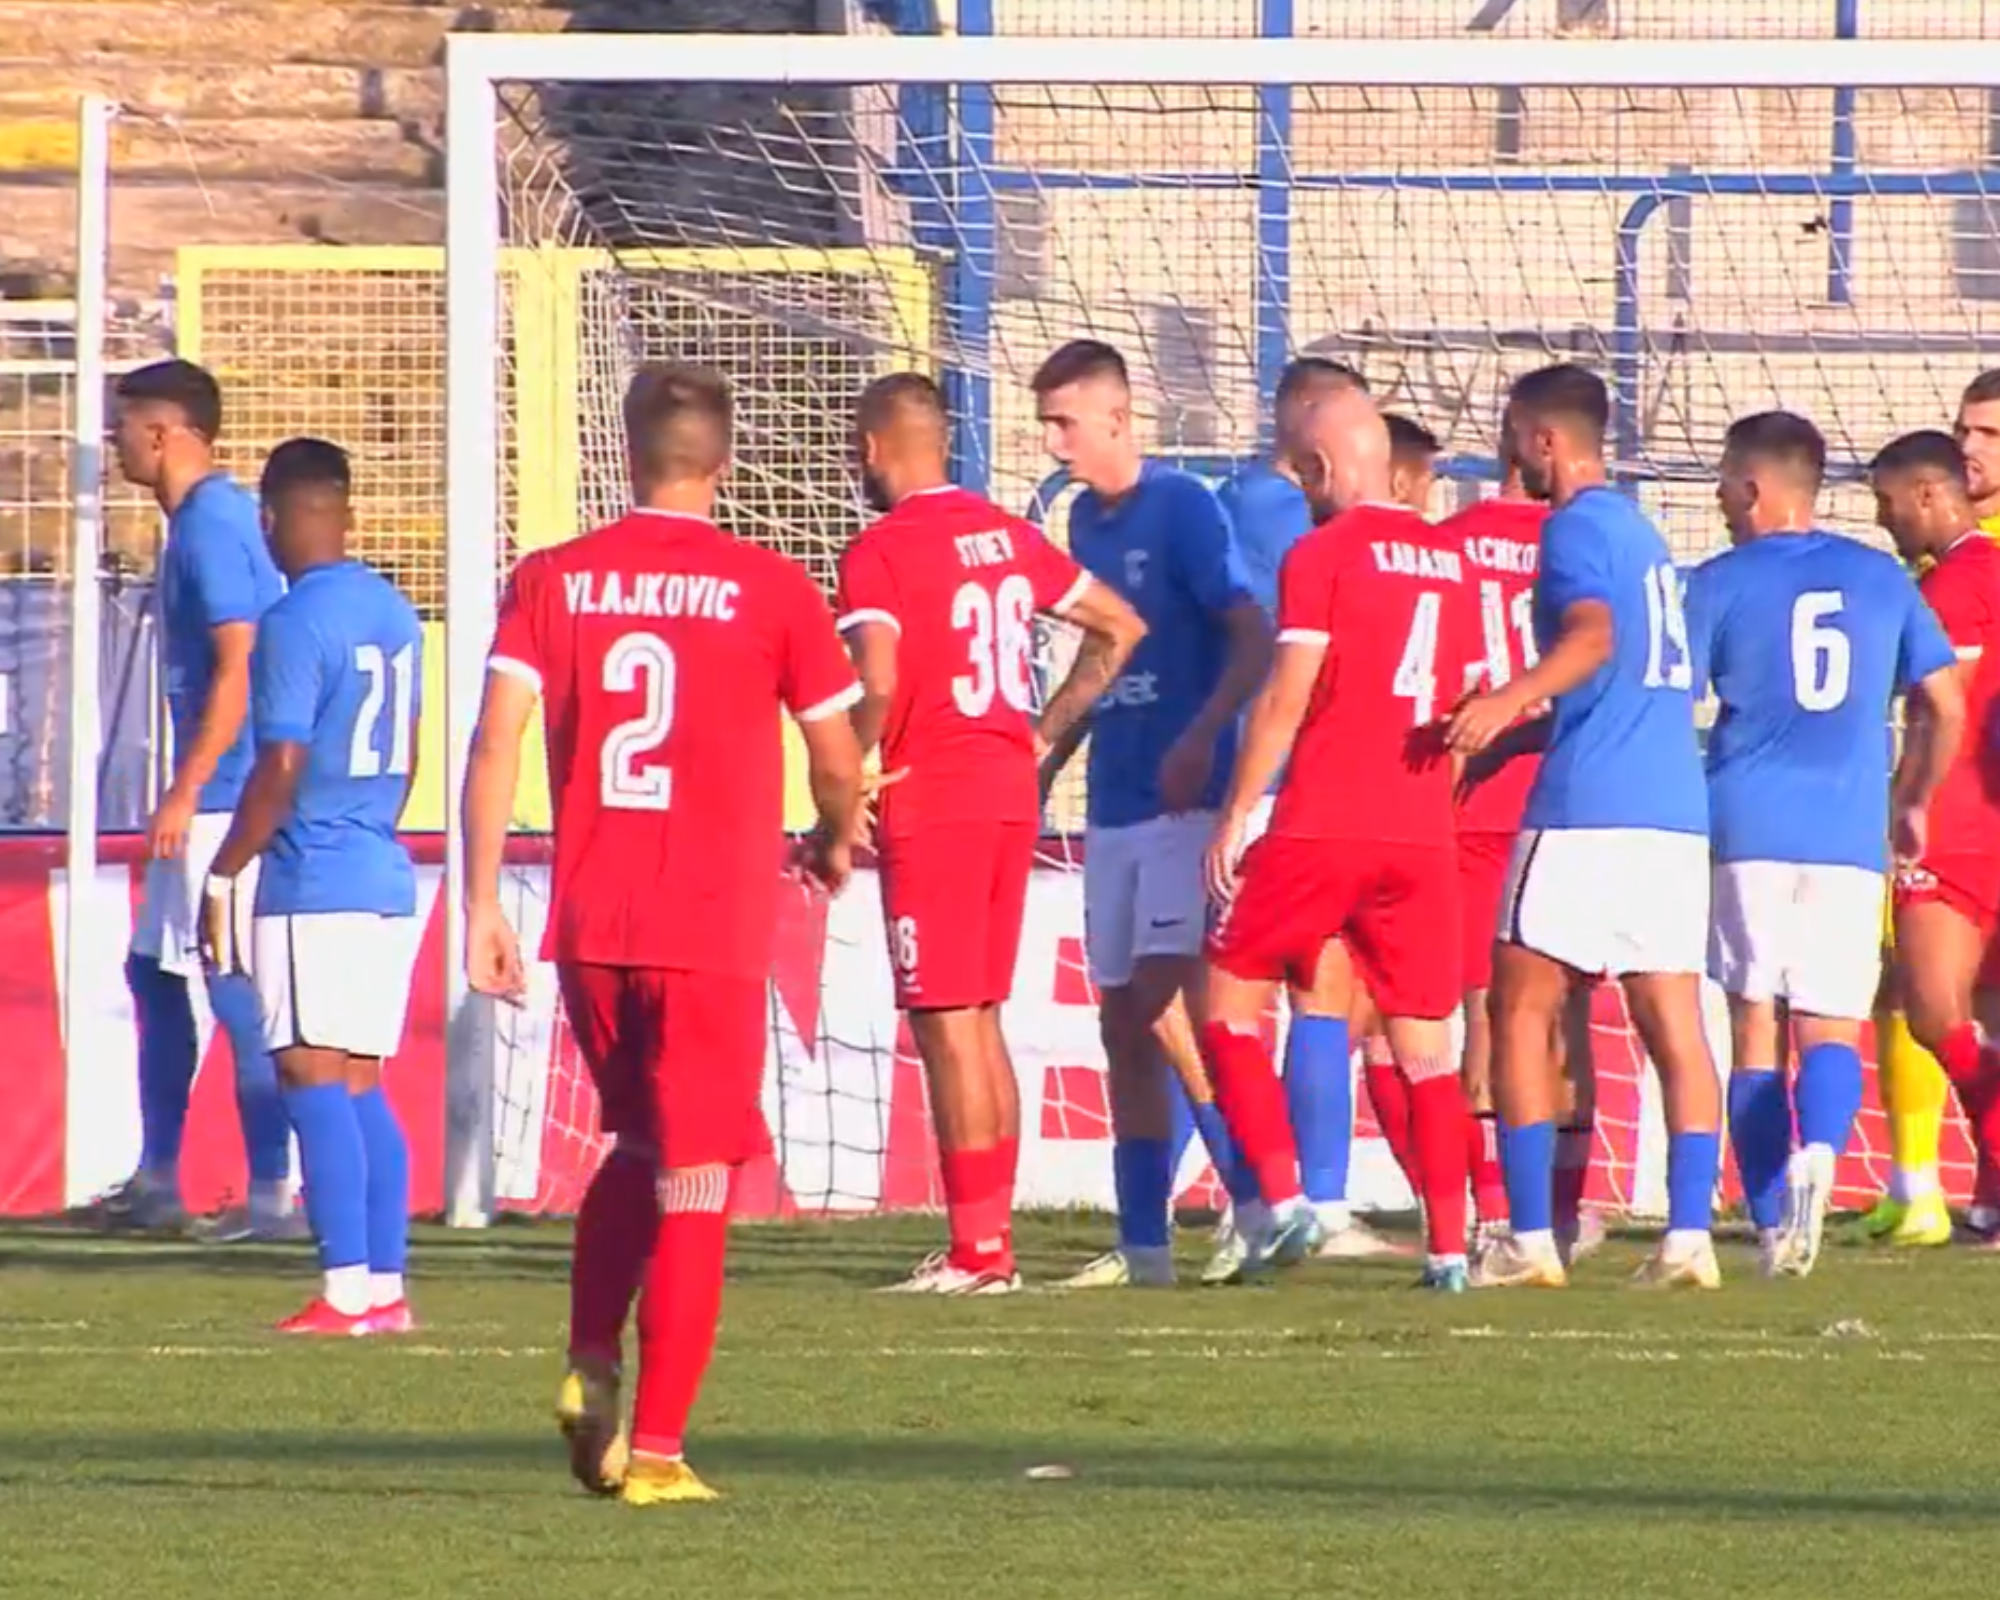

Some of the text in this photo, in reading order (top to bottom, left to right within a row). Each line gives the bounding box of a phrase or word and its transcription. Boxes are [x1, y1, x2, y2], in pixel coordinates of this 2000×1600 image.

[563, 571, 740, 621] VLAJKOVIC
[1392, 592, 1440, 726] 4
[1791, 590, 1849, 712] 6
[349, 642, 414, 777] 21
[600, 631, 676, 811] 2
